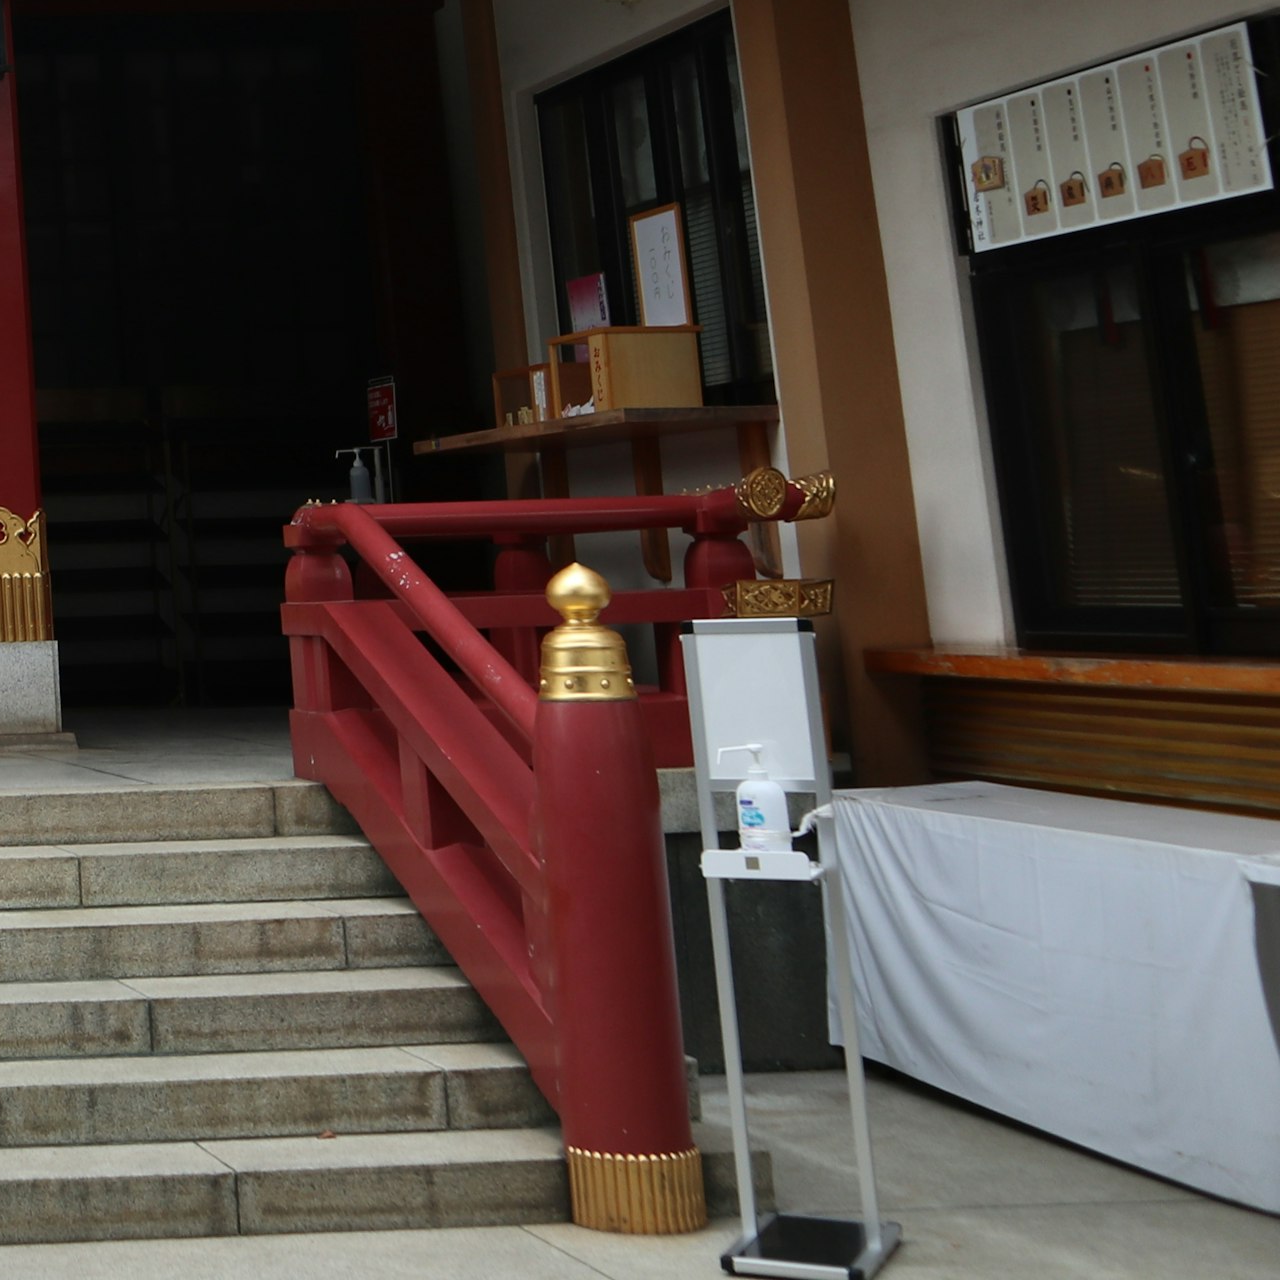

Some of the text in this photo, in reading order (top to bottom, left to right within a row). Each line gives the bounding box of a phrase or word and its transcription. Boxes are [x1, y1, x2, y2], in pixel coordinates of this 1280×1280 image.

[660, 225, 675, 300] おみくじ
[592, 346, 604, 402] おみくじ
